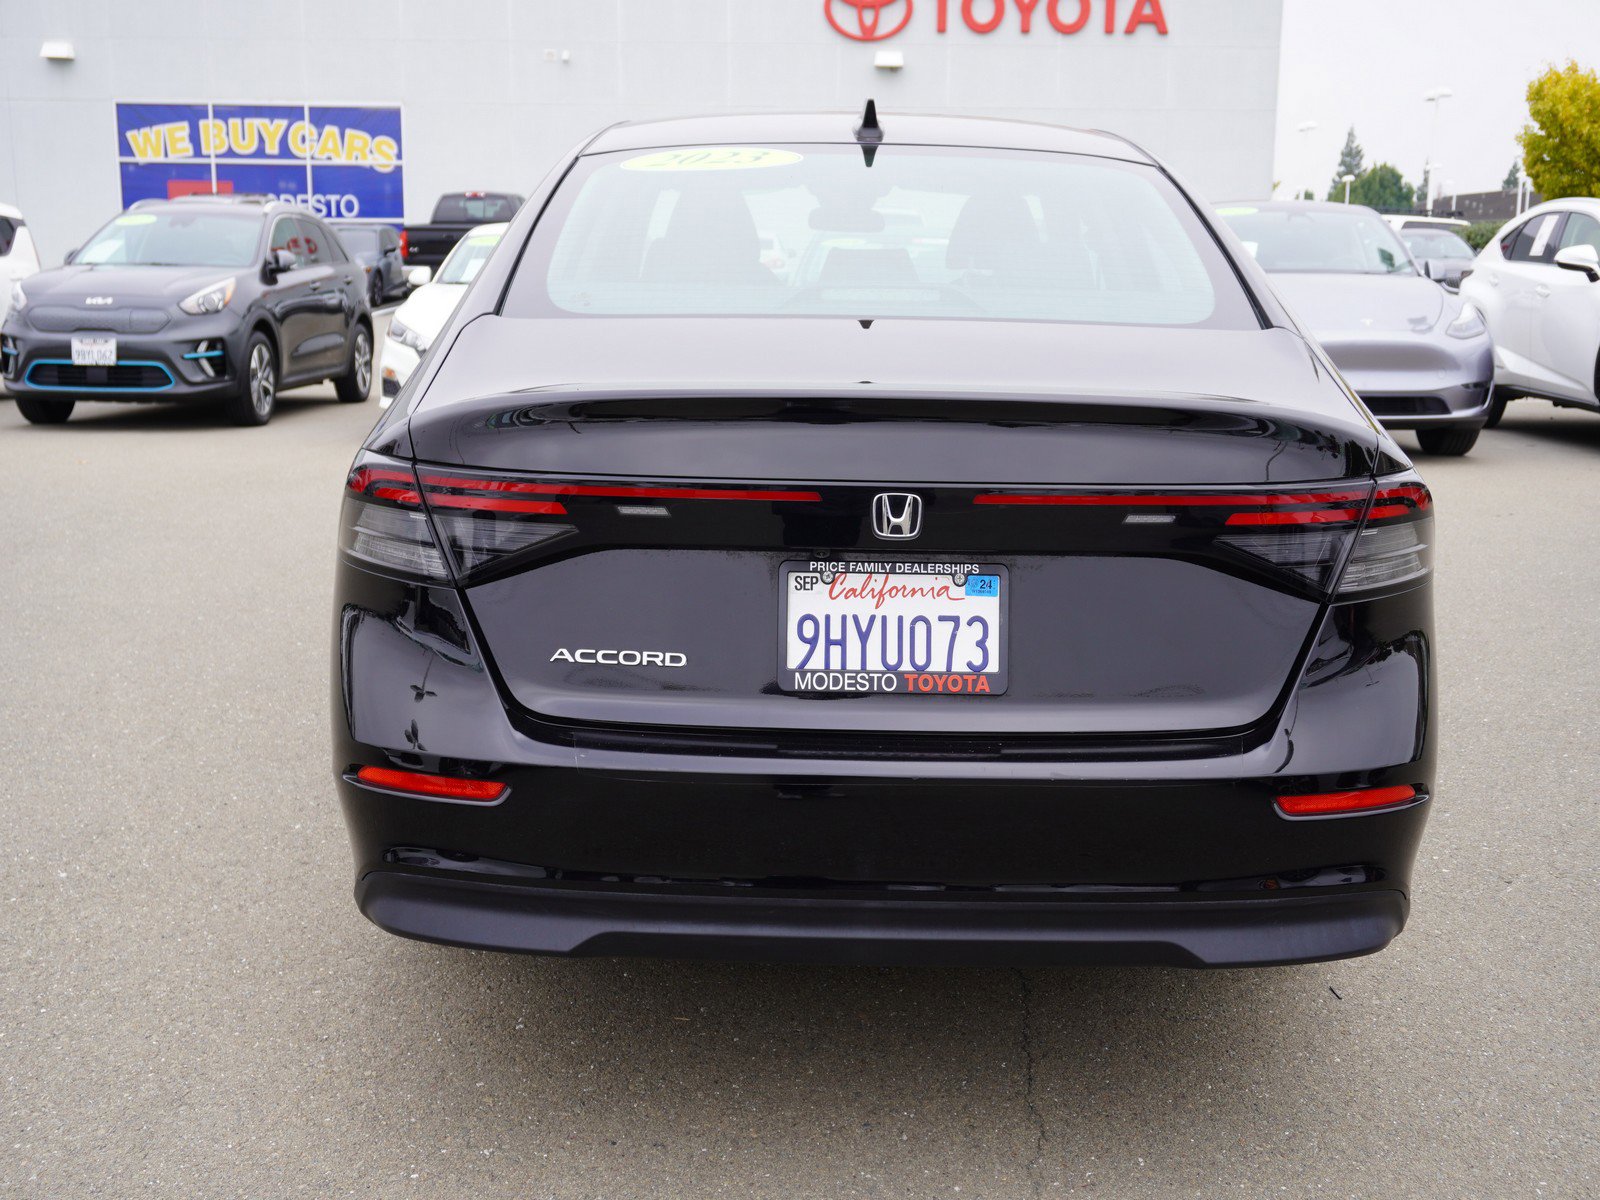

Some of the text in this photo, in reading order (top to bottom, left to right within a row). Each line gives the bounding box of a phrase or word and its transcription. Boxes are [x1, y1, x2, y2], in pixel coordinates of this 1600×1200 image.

[937, 0, 1168, 34] TOYOTA
[126, 118, 399, 173] WE BUY CARS
[809, 562, 979, 574] PRICE FAMILY DEALERSHIPS
[794, 575, 819, 591] SEP
[829, 573, 965, 609] California
[980, 579, 993, 590] 24
[796, 613, 990, 672] 9HYU073
[550, 648, 688, 667] ACCORD
[794, 672, 990, 693] MODESTO TOYOTA
